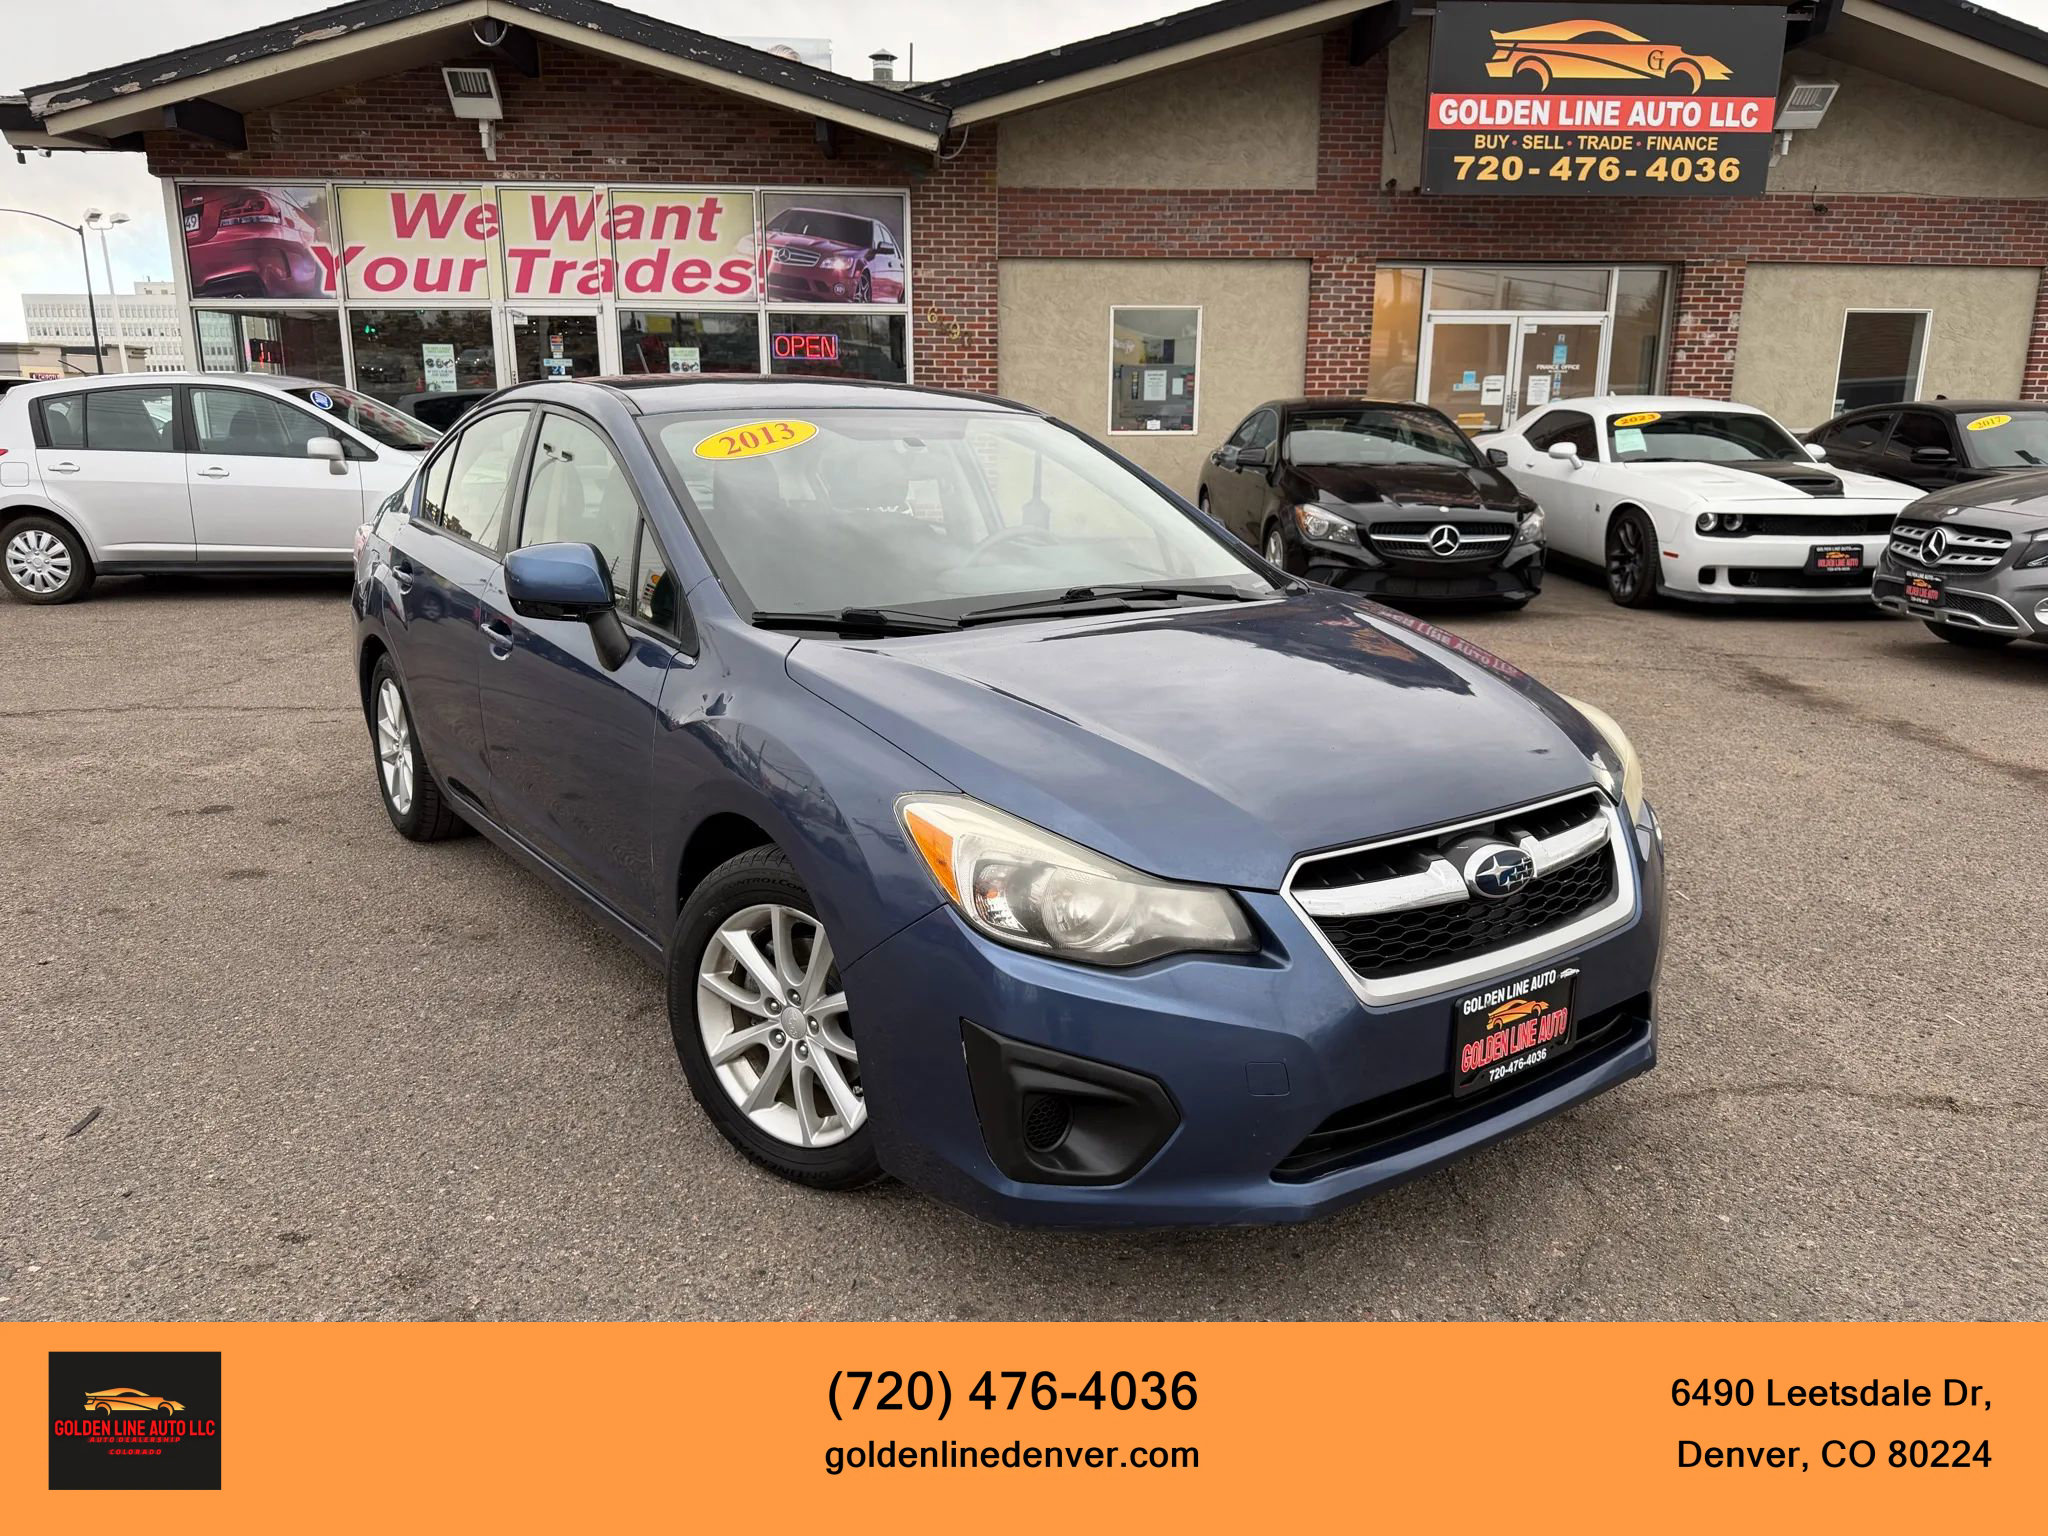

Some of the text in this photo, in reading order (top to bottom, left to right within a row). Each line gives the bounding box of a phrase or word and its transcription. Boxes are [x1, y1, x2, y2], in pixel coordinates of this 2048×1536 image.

[1648, 49, 1665, 71] G
[1438, 98, 1759, 128] GOLDEN LINE AUTO LLC
[1474, 134, 1718, 151] BUY SELL TRADE FINANCE
[391, 192, 723, 241] We Want
[310, 246, 773, 295] Your Trades!
[775, 335, 837, 358] OPEN
[1621, 414, 1656, 425] 2023
[718, 422, 796, 456] 2013
[1463, 969, 1557, 1015] GOLDEN LINE AUTO
[1461, 1007, 1569, 1073] GOLDEN LINE AUTO
[1489, 1048, 1547, 1082] 720-476-4036
